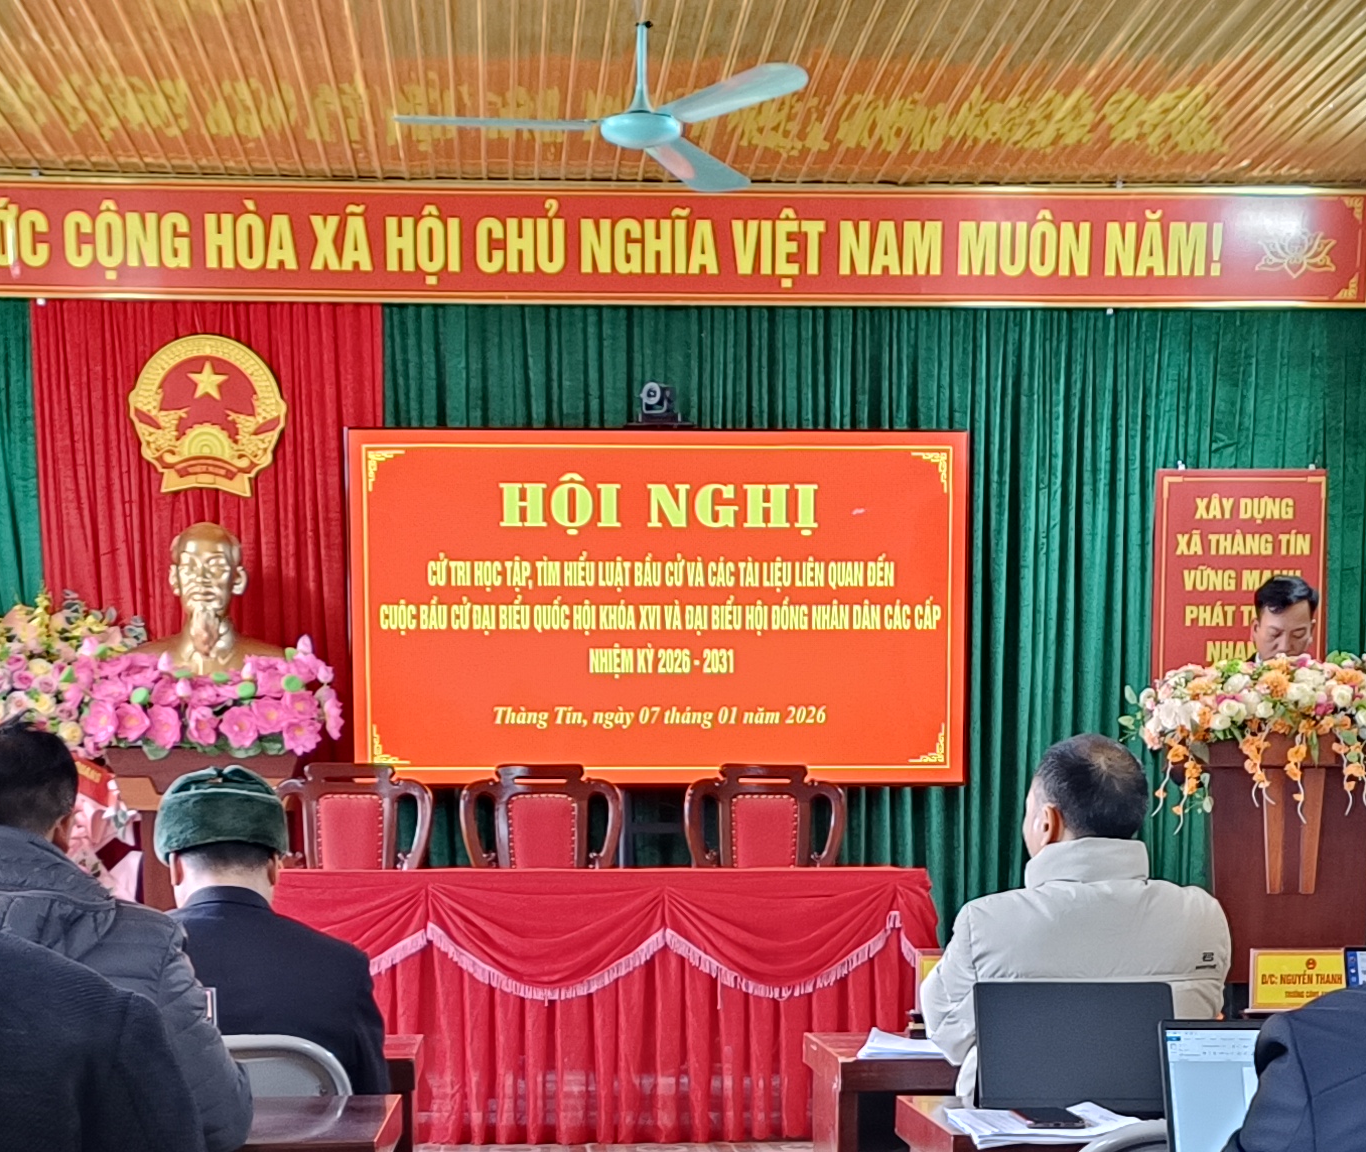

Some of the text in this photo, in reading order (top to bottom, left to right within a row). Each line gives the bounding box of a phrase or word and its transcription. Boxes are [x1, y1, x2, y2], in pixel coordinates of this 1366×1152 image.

[64, 199, 190, 280] CỘNG
[204, 199, 298, 270] HÒA
[309, 203, 373, 271] XÃ
[385, 204, 461, 285] HỘI
[476, 199, 565, 273] CHỦ
[580, 207, 719, 275] NGHĨA
[732, 207, 825, 288] VIỆT
[839, 220, 942, 275] NAM
[958, 209, 1091, 276] MUÔN
[1104, 209, 1223, 276] NĂM!
[499, 473, 818, 536] HỘI NGHỊ
[1195, 493, 1294, 524] XÂY DỰNG
[1176, 529, 1311, 555] XÃ THÀNG TÍN
[428, 553, 448, 586] CỬ
[450, 561, 470, 586] TRI
[474, 561, 501, 592] HỌC
[505, 556, 533, 592] TẬP,
[536, 556, 560, 586] TÌM
[564, 551, 595, 586] HIỂU
[598, 556, 631, 592] LUẬT
[665, 553, 685, 586] CỬ
[687, 556, 705, 586] VÀ
[708, 556, 735, 586] CÁC
[738, 556, 759, 586] TÀI
[763, 556, 791, 592] LIỆU
[795, 556, 824, 586] LIÊN
[828, 561, 864, 589] QUAN
[867, 553, 894, 586] ĐẾN
[1183, 565, 1236, 591] VỮNG
[380, 599, 417, 635] CUỘC
[451, 596, 471, 629] CỬ
[473, 604, 496, 635] ĐẠI
[499, 594, 530, 629] BIỂU
[534, 596, 570, 632] QUỐC
[573, 599, 596, 635] HỘI
[599, 599, 635, 629] KHÓA
[639, 604, 661, 629] XVI
[665, 600, 681, 629] VÀ
[685, 604, 708, 635] ĐẠI
[711, 595, 742, 629] BIỂU
[745, 600, 768, 636] HỘI
[772, 596, 808, 629] ĐỒNG
[812, 599, 849, 629] NHÂN
[853, 599, 881, 629] DÂN
[884, 599, 911, 629] CÁC
[914, 596, 941, 629] CẤP
[1185, 601, 1235, 626] PHÁT
[589, 643, 633, 678] NHIỆM
[637, 643, 654, 673] KỲ
[658, 648, 691, 673] 2026
[703, 648, 734, 673] 2031
[493, 705, 826, 729] Thàng Tín, ngày 07 tháng 01 năm 2026
